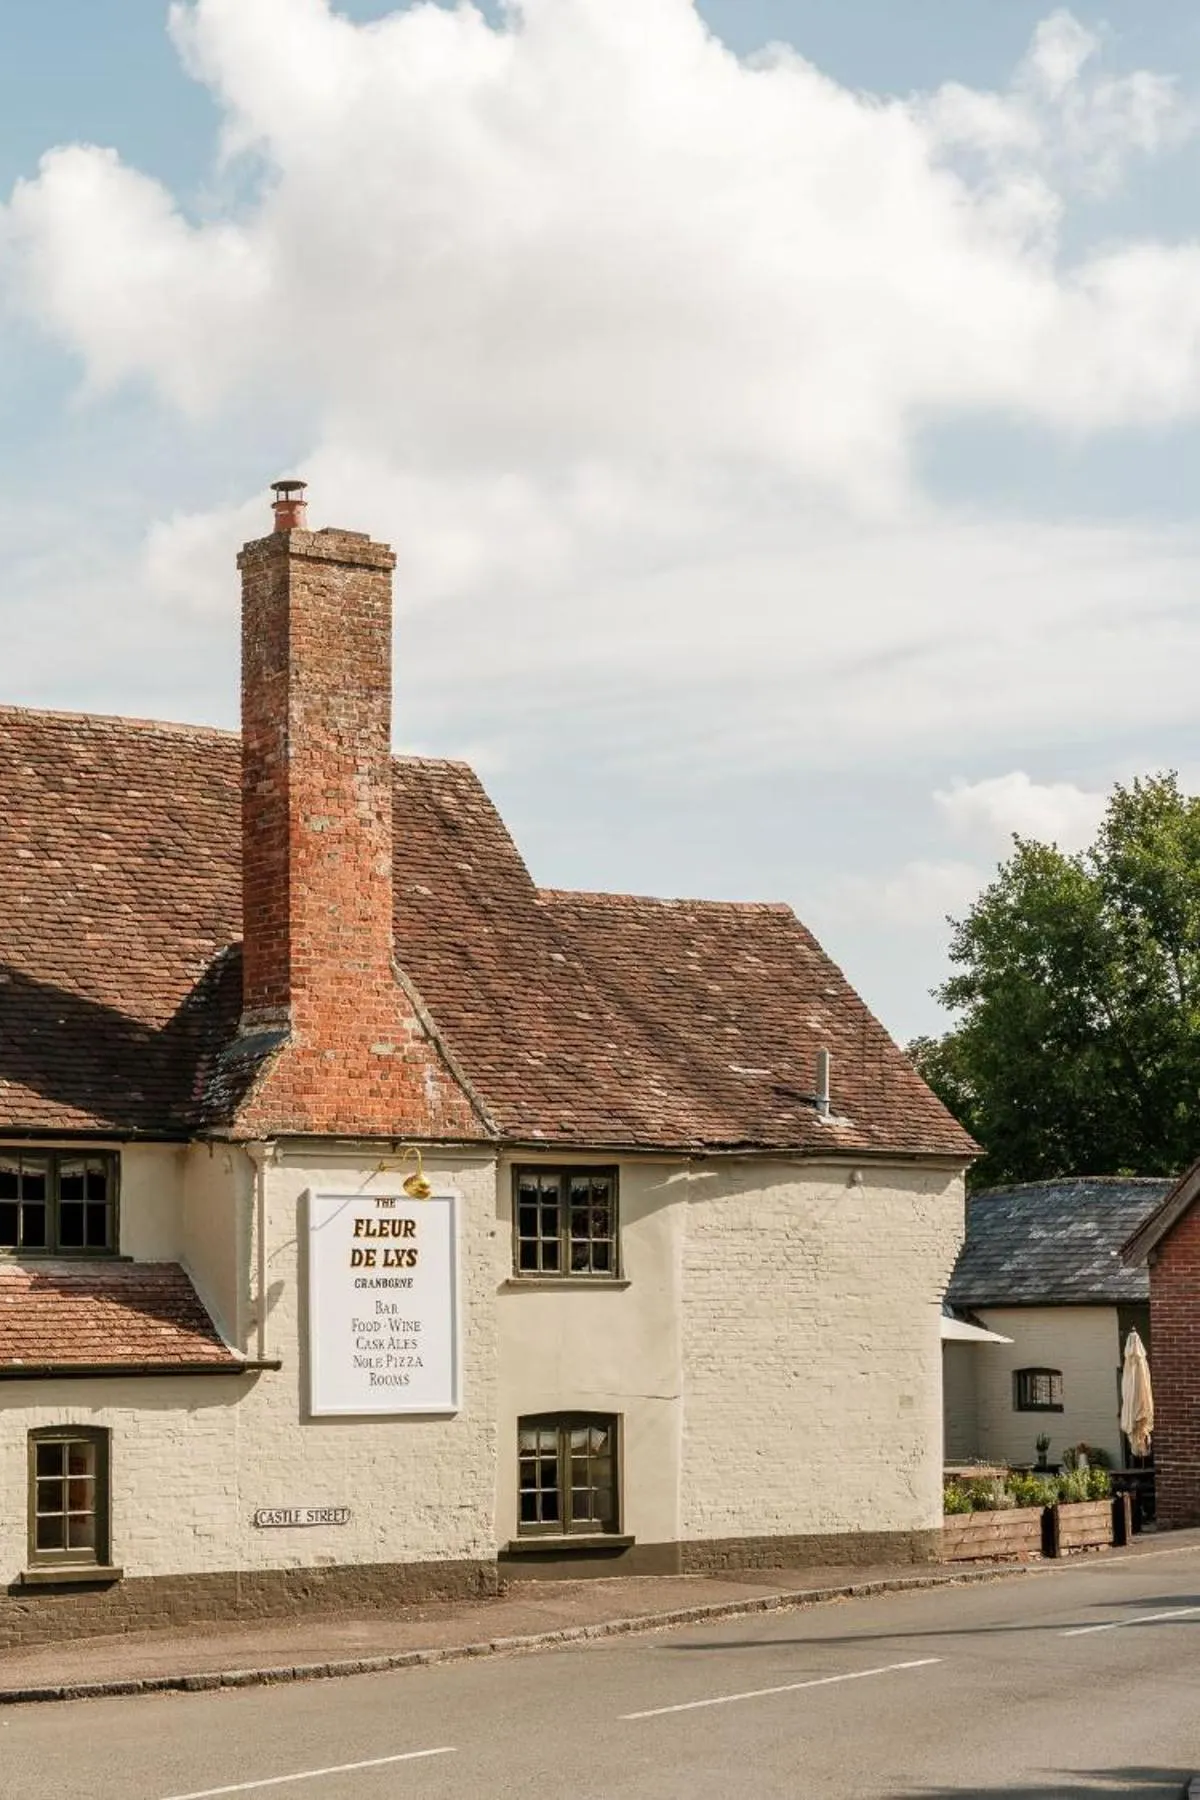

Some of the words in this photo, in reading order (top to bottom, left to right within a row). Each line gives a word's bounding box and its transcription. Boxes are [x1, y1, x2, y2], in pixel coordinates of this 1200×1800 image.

[374, 1197, 397, 1208] THE
[353, 1218, 416, 1238] FLEUR
[350, 1249, 376, 1268] DE
[383, 1249, 418, 1267] LYS
[354, 1278, 414, 1289] CRANBORNE
[260, 1510, 301, 1523] CASTLE
[307, 1508, 346, 1522] STREET
